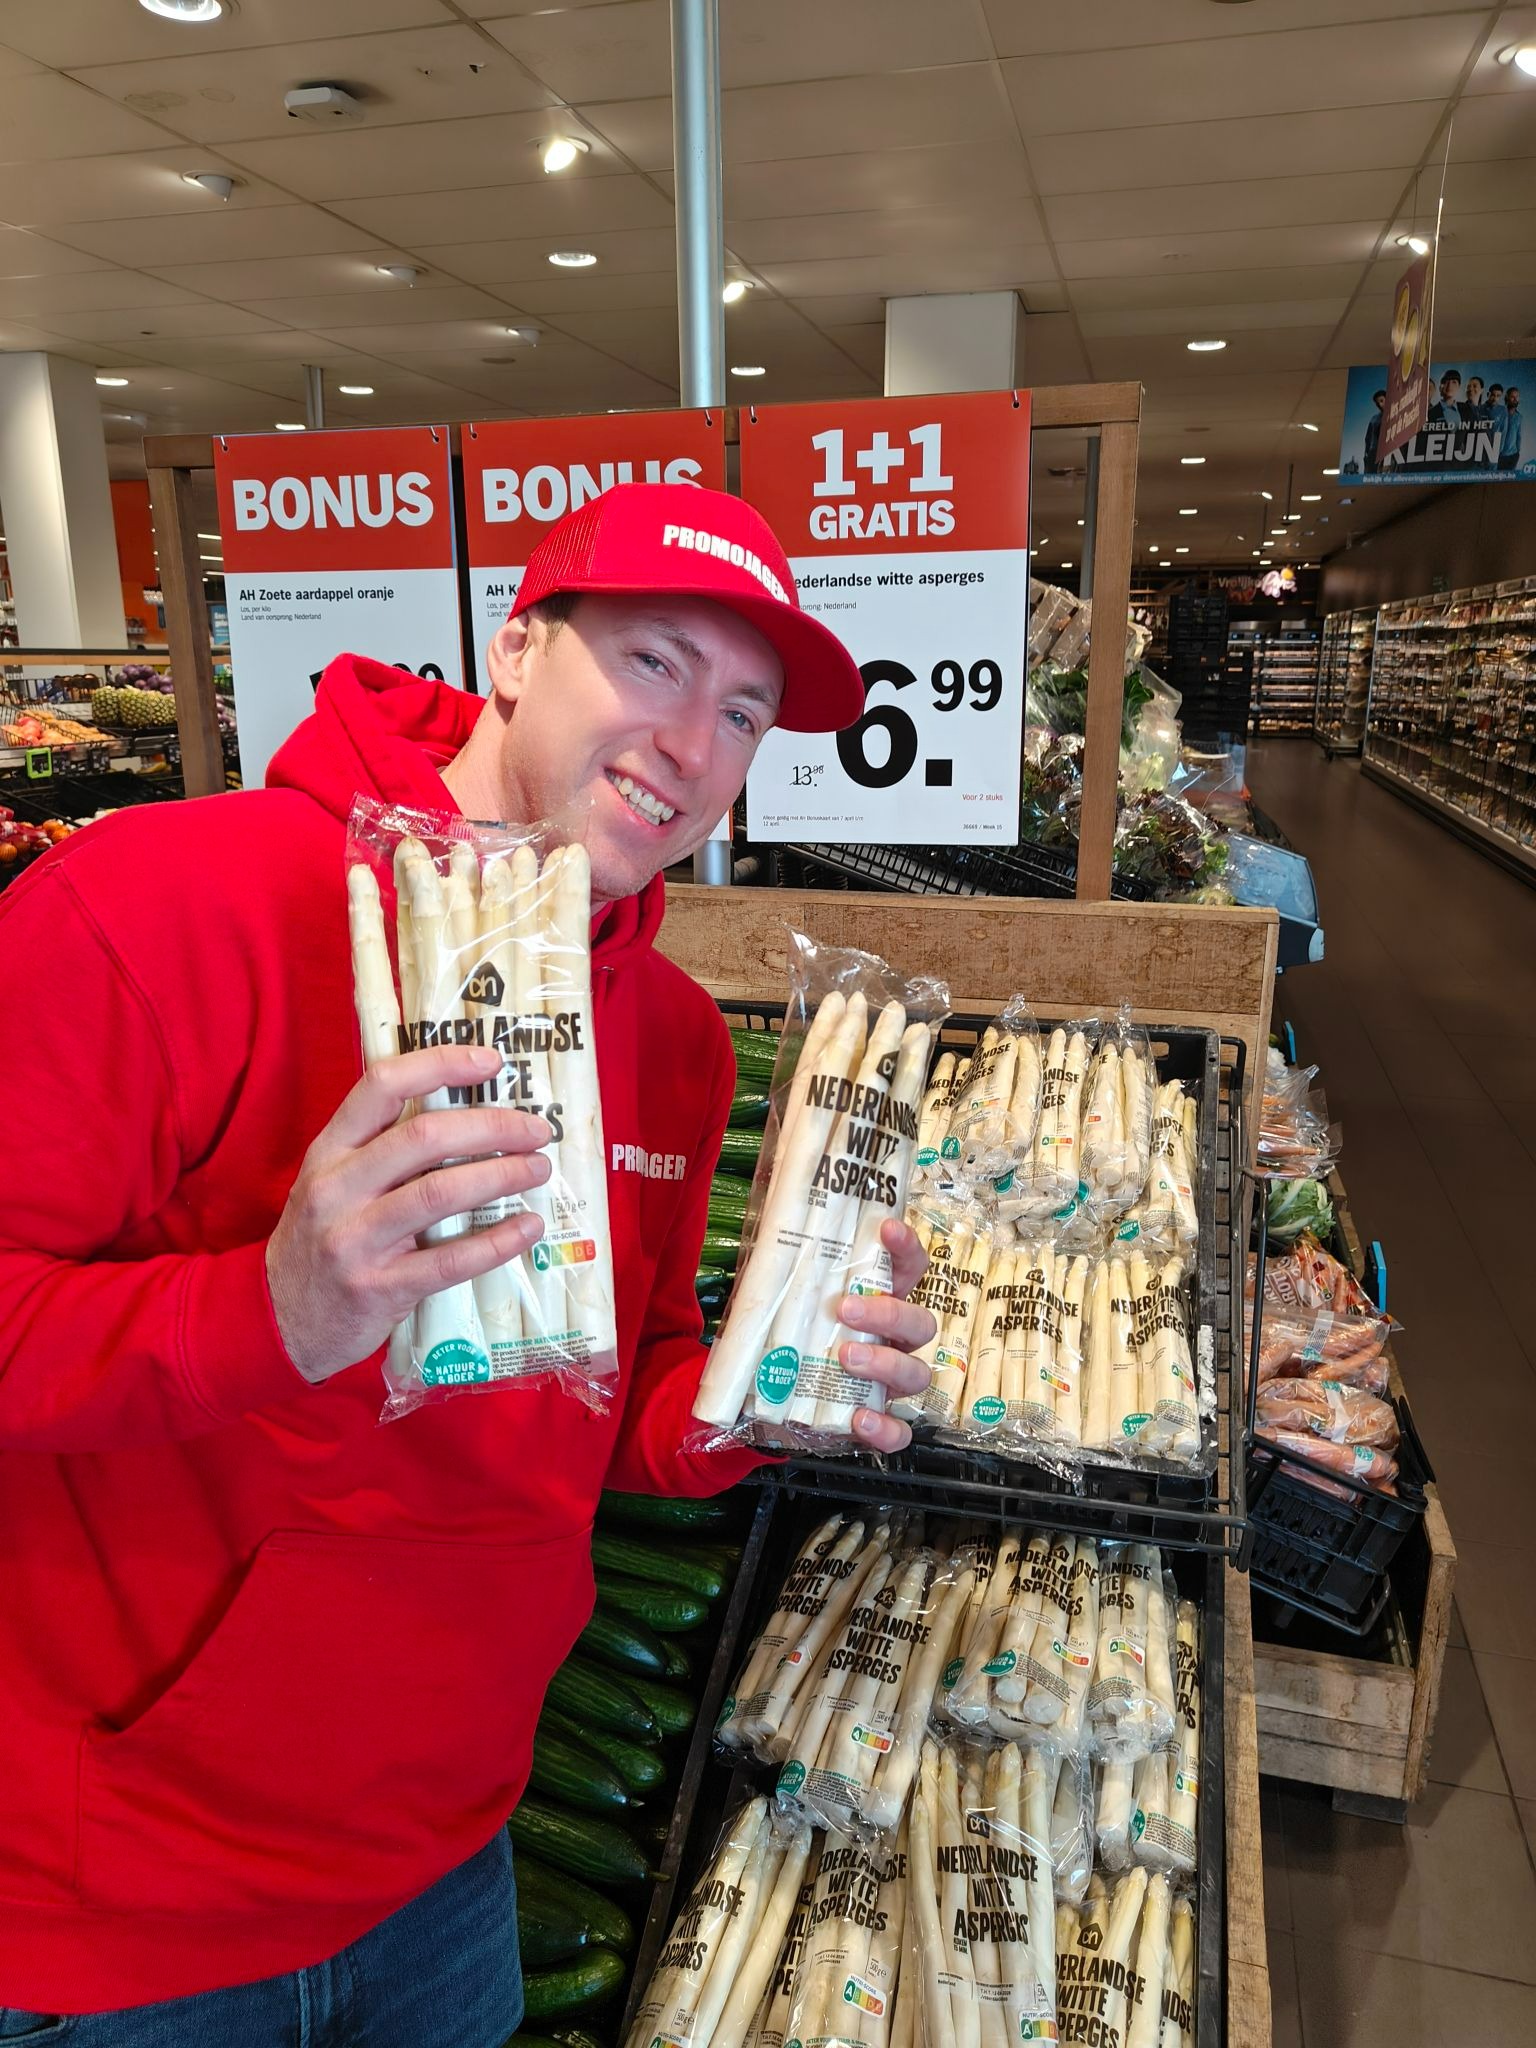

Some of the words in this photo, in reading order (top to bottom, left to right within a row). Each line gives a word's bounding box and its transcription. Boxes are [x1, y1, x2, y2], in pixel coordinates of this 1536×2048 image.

[1422, 422, 1455, 432] ERELD
[1458, 421, 1471, 431] IN
[1473, 419, 1495, 430] HET
[811, 423, 955, 497] 1+1
[232, 471, 434, 531] BONUS
[809, 499, 956, 541] GRATIS
[240, 589, 256, 601] AH
[259, 589, 292, 601] Zoete
[295, 587, 354, 602] aardappel
[357, 586, 395, 602] oranje
[486, 584, 505, 597] AH
[795, 573, 872, 588] ederlandse
[877, 571, 914, 586] witte
[918, 571, 985, 588] asperges
[823, 602, 857, 610] Nederland
[962, 793, 978, 801] Voor
[985, 793, 1004, 801] stuks
[539, 1230, 582, 1243] URI-SCORE
[927, 1262, 985, 1291] RLANDSE
[910, 1288, 969, 1318] SPERGES
[986, 1284, 1080, 1318] NEDERLANDSE
[1010, 1299, 1053, 1321] WITTE
[1110, 1285, 1184, 1316] NEDERLAND
[992, 1315, 1063, 1344] ASPERGES
[1126, 1313, 1186, 1347] ASPERGES
[432, 1343, 455, 1360] BETER
[435, 1361, 476, 1376] NATUUR
[447, 1371, 475, 1384] BOER
[768, 1365, 794, 1377] NATUUR
[1008, 1575, 1084, 1616] ASPERGES
[1030, 1565, 1075, 1599] WITTE
[850, 1607, 932, 1645] ERLANDSE
[845, 1627, 895, 1659] WITTE
[817, 1848, 908, 1883] EDERLANDSE
[972, 1877, 1016, 1908] WITTE
[809, 1894, 889, 1932] ASPERGES
[1055, 1953, 1147, 2006] ERLANDSE
[1057, 1983, 1109, 2018] WITTE
[1057, 2011, 1120, 2048] PERGES
